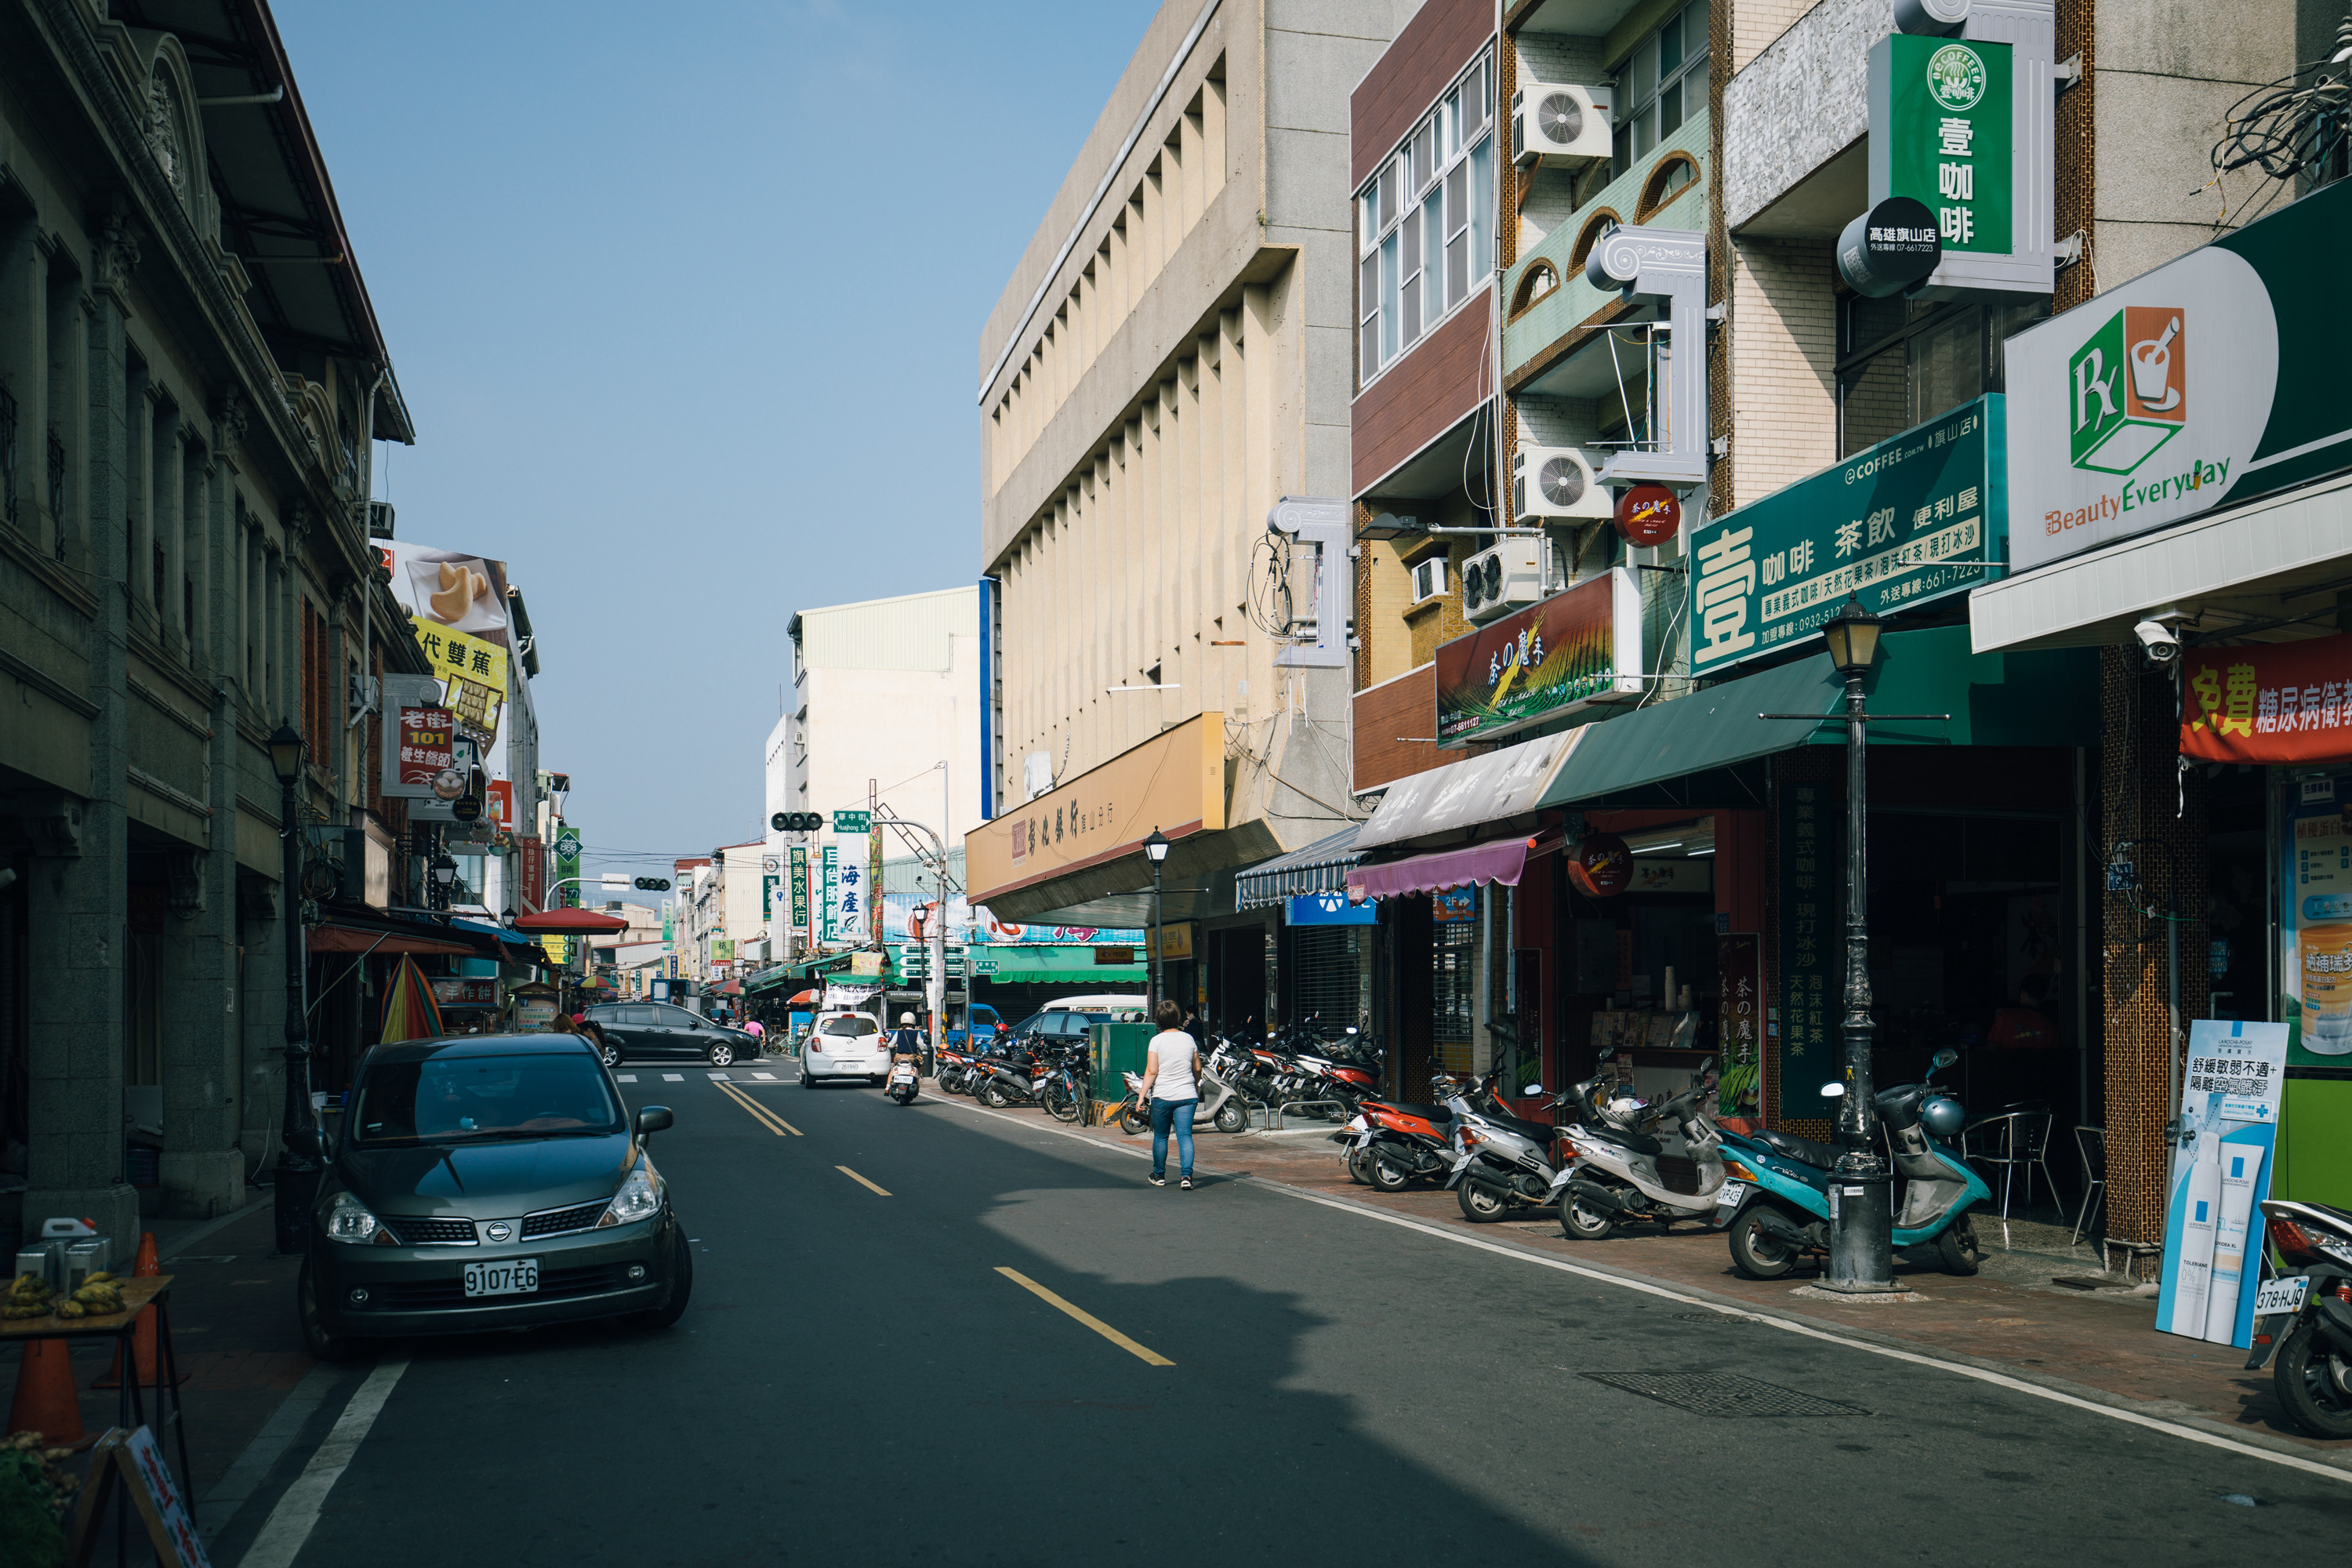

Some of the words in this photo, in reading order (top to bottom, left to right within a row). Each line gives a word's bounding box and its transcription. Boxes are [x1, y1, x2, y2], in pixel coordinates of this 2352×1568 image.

[1940, 85, 1975, 100] 壹咖啡
[1938, 117, 1974, 244] 壹咖啡
[1869, 227, 1936, 242] 高雄旗山店
[1896, 244, 1933, 252] 07-6617223
[1934, 416, 1971, 448] 旗山店
[1632, 499, 1671, 514] 茶の魔手
[1762, 539, 1814, 586] 咖啡
[1835, 507, 1896, 560] 茶飲
[1912, 486, 1978, 530] 便利屋
[1694, 525, 1755, 664] 壹
[1488, 628, 1544, 685] 茶の魔手
[2191, 662, 2257, 738] 免費
[401, 710, 452, 729] 老街
[1450, 716, 1479, 734] 07-6611127
[408, 731, 446, 746] 101
[401, 746, 452, 768] 養生饅頭
[1029, 798, 1078, 857] 彰化銀行
[1081, 803, 1112, 833] 旗山分行
[560, 839, 577, 855] 藥
[1588, 851, 1624, 866] 茶の魔手
[792, 849, 806, 924] 旗美水果行
[841, 865, 860, 913] 海產
[1445, 897, 1457, 906] 2F
[1735, 976, 1753, 1065] 茶の魔手
[1789, 975, 1804, 1057] 天然花果茶
[1809, 975, 1824, 1044] 泡沫紅茶
[2183, 1259, 2208, 1269] TOLERIANE
[2181, 1269, 2195, 1282] 0%
